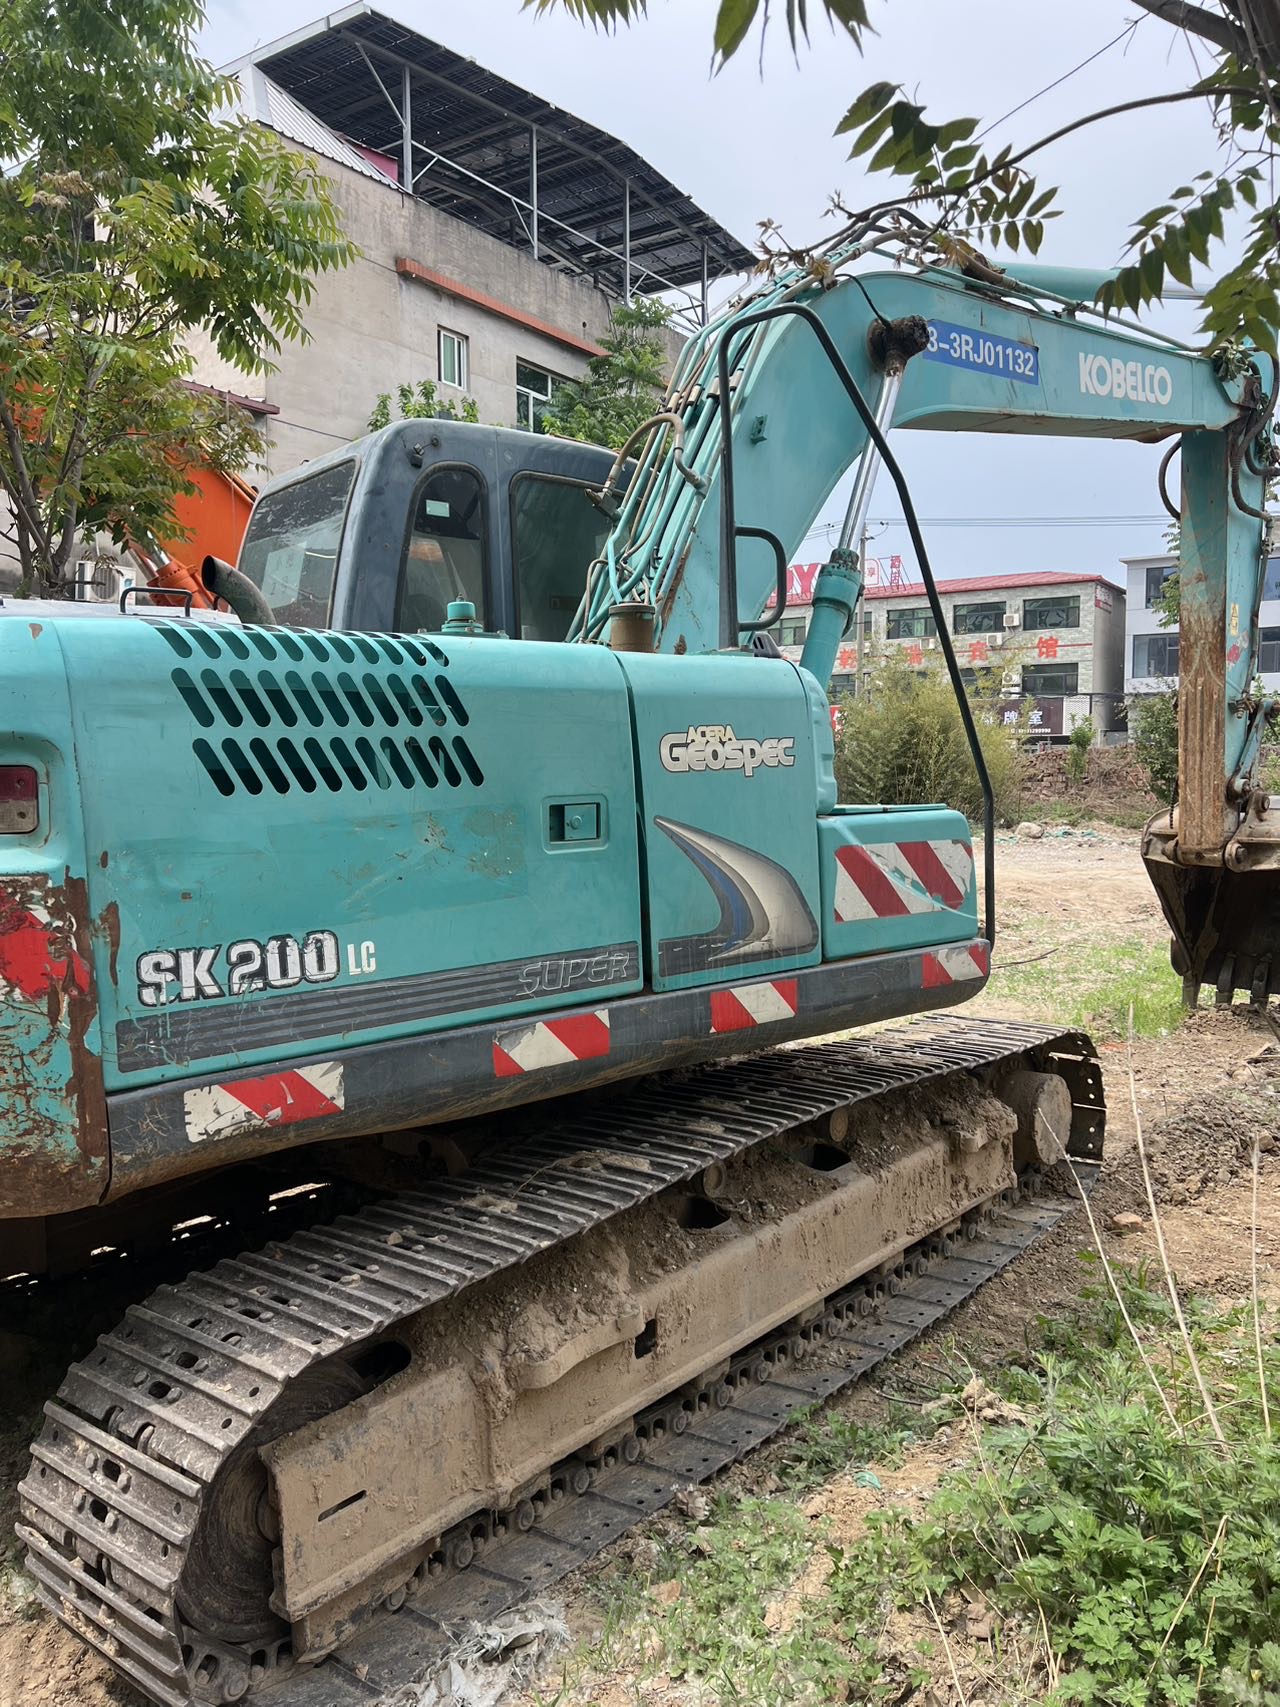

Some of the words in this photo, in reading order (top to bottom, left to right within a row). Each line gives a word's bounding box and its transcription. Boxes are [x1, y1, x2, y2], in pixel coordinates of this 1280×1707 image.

[1079, 351, 1173, 406] KOBELCO
[686, 724, 736, 743] ACERA
[137, 929, 341, 1007] SK200
[347, 940, 376, 976] LC
[516, 952, 630, 998] SUPER
